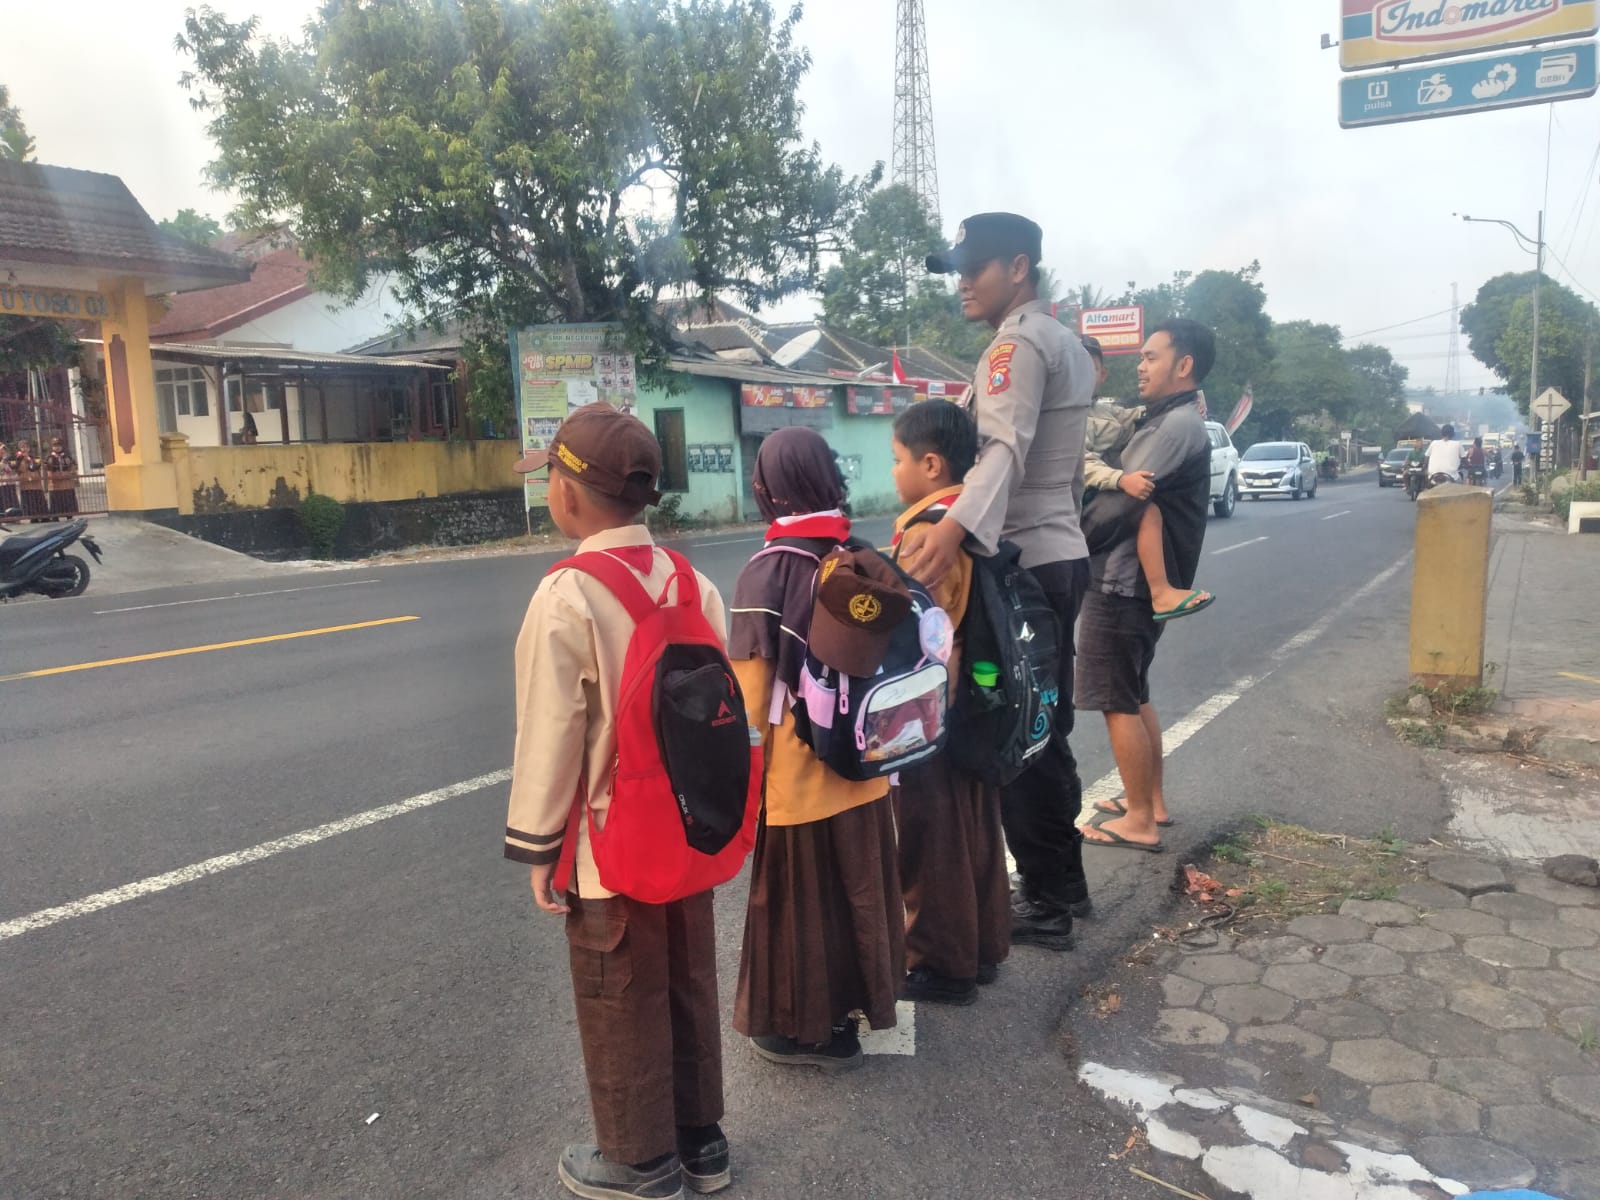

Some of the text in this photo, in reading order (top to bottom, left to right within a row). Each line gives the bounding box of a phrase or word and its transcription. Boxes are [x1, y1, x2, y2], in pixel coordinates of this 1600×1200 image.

[1381, 0, 1553, 34] Indomare
[1364, 100, 1392, 112] pulsa
[1086, 311, 1137, 323] Alfamart
[522, 354, 543, 364] JOIN
[545, 353, 593, 370] SPMB
